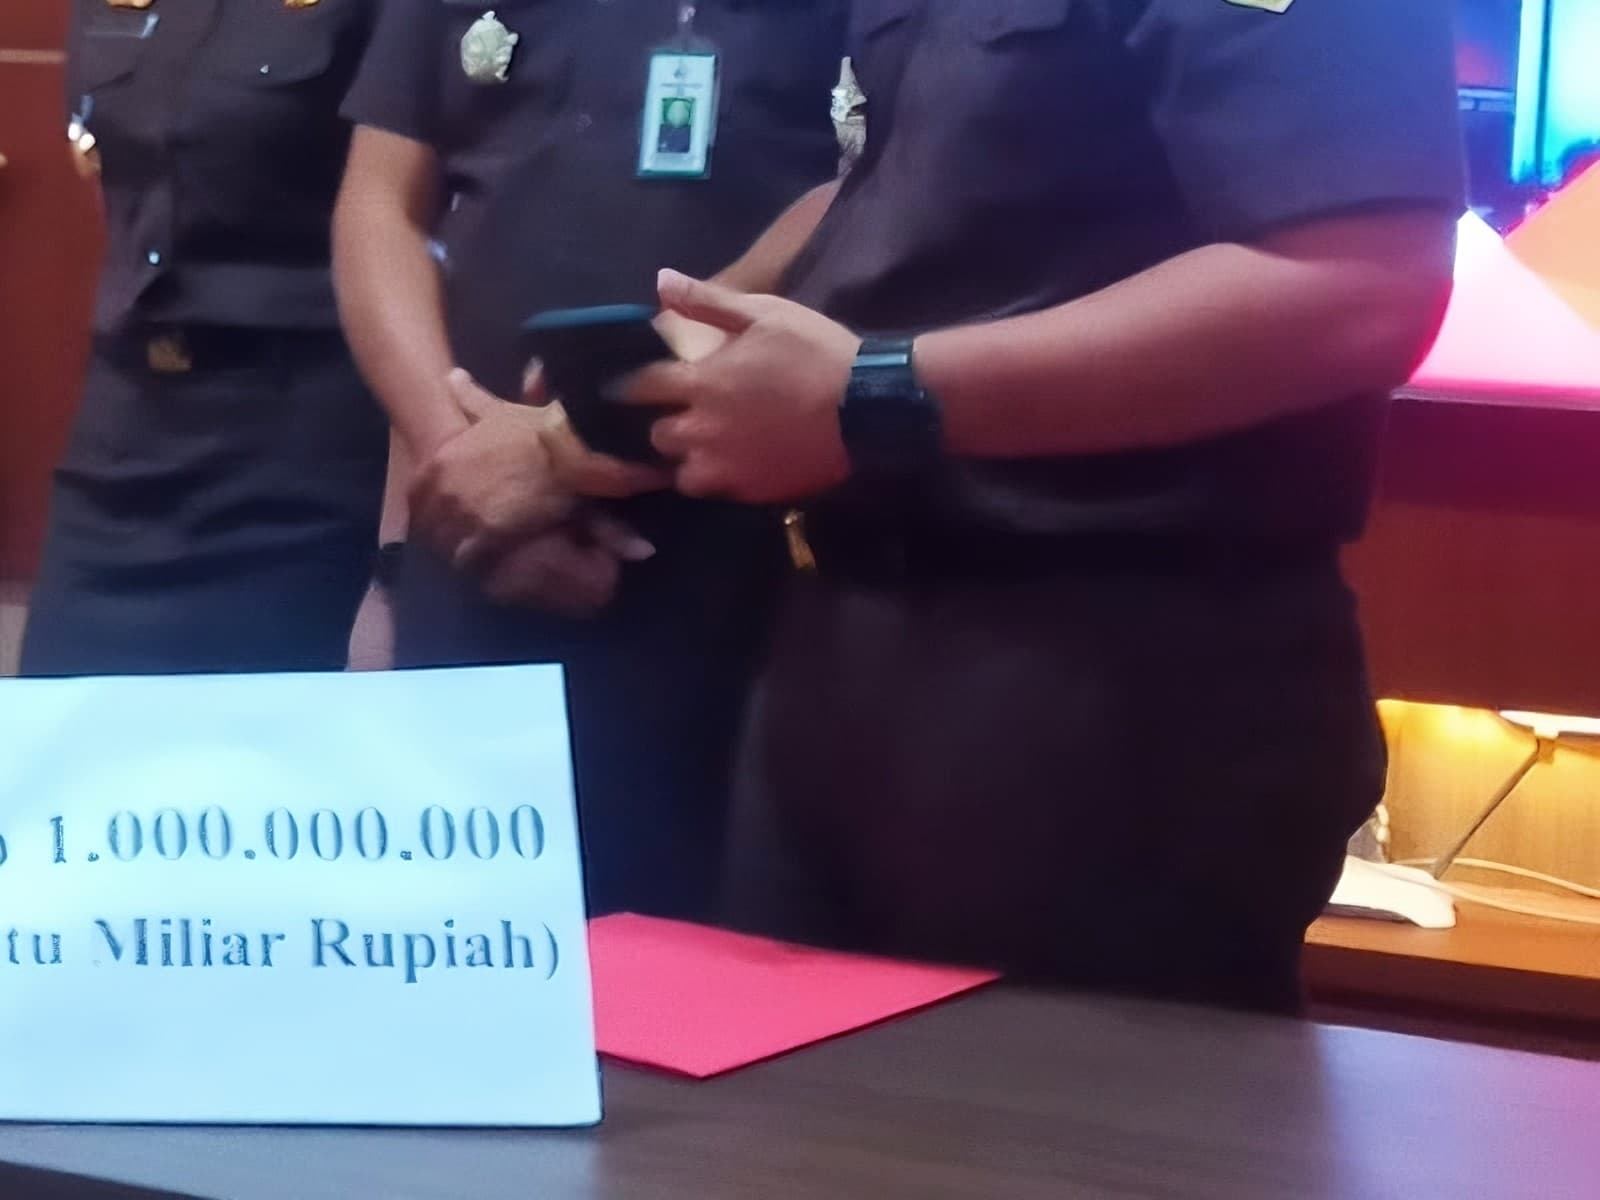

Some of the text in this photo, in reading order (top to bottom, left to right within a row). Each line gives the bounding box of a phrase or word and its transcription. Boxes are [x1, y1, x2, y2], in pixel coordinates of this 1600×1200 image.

[49, 804, 546, 864] 1.000.000.000
[93, 916, 285, 968] Miliar
[311, 917, 561, 984] Rupiah)
